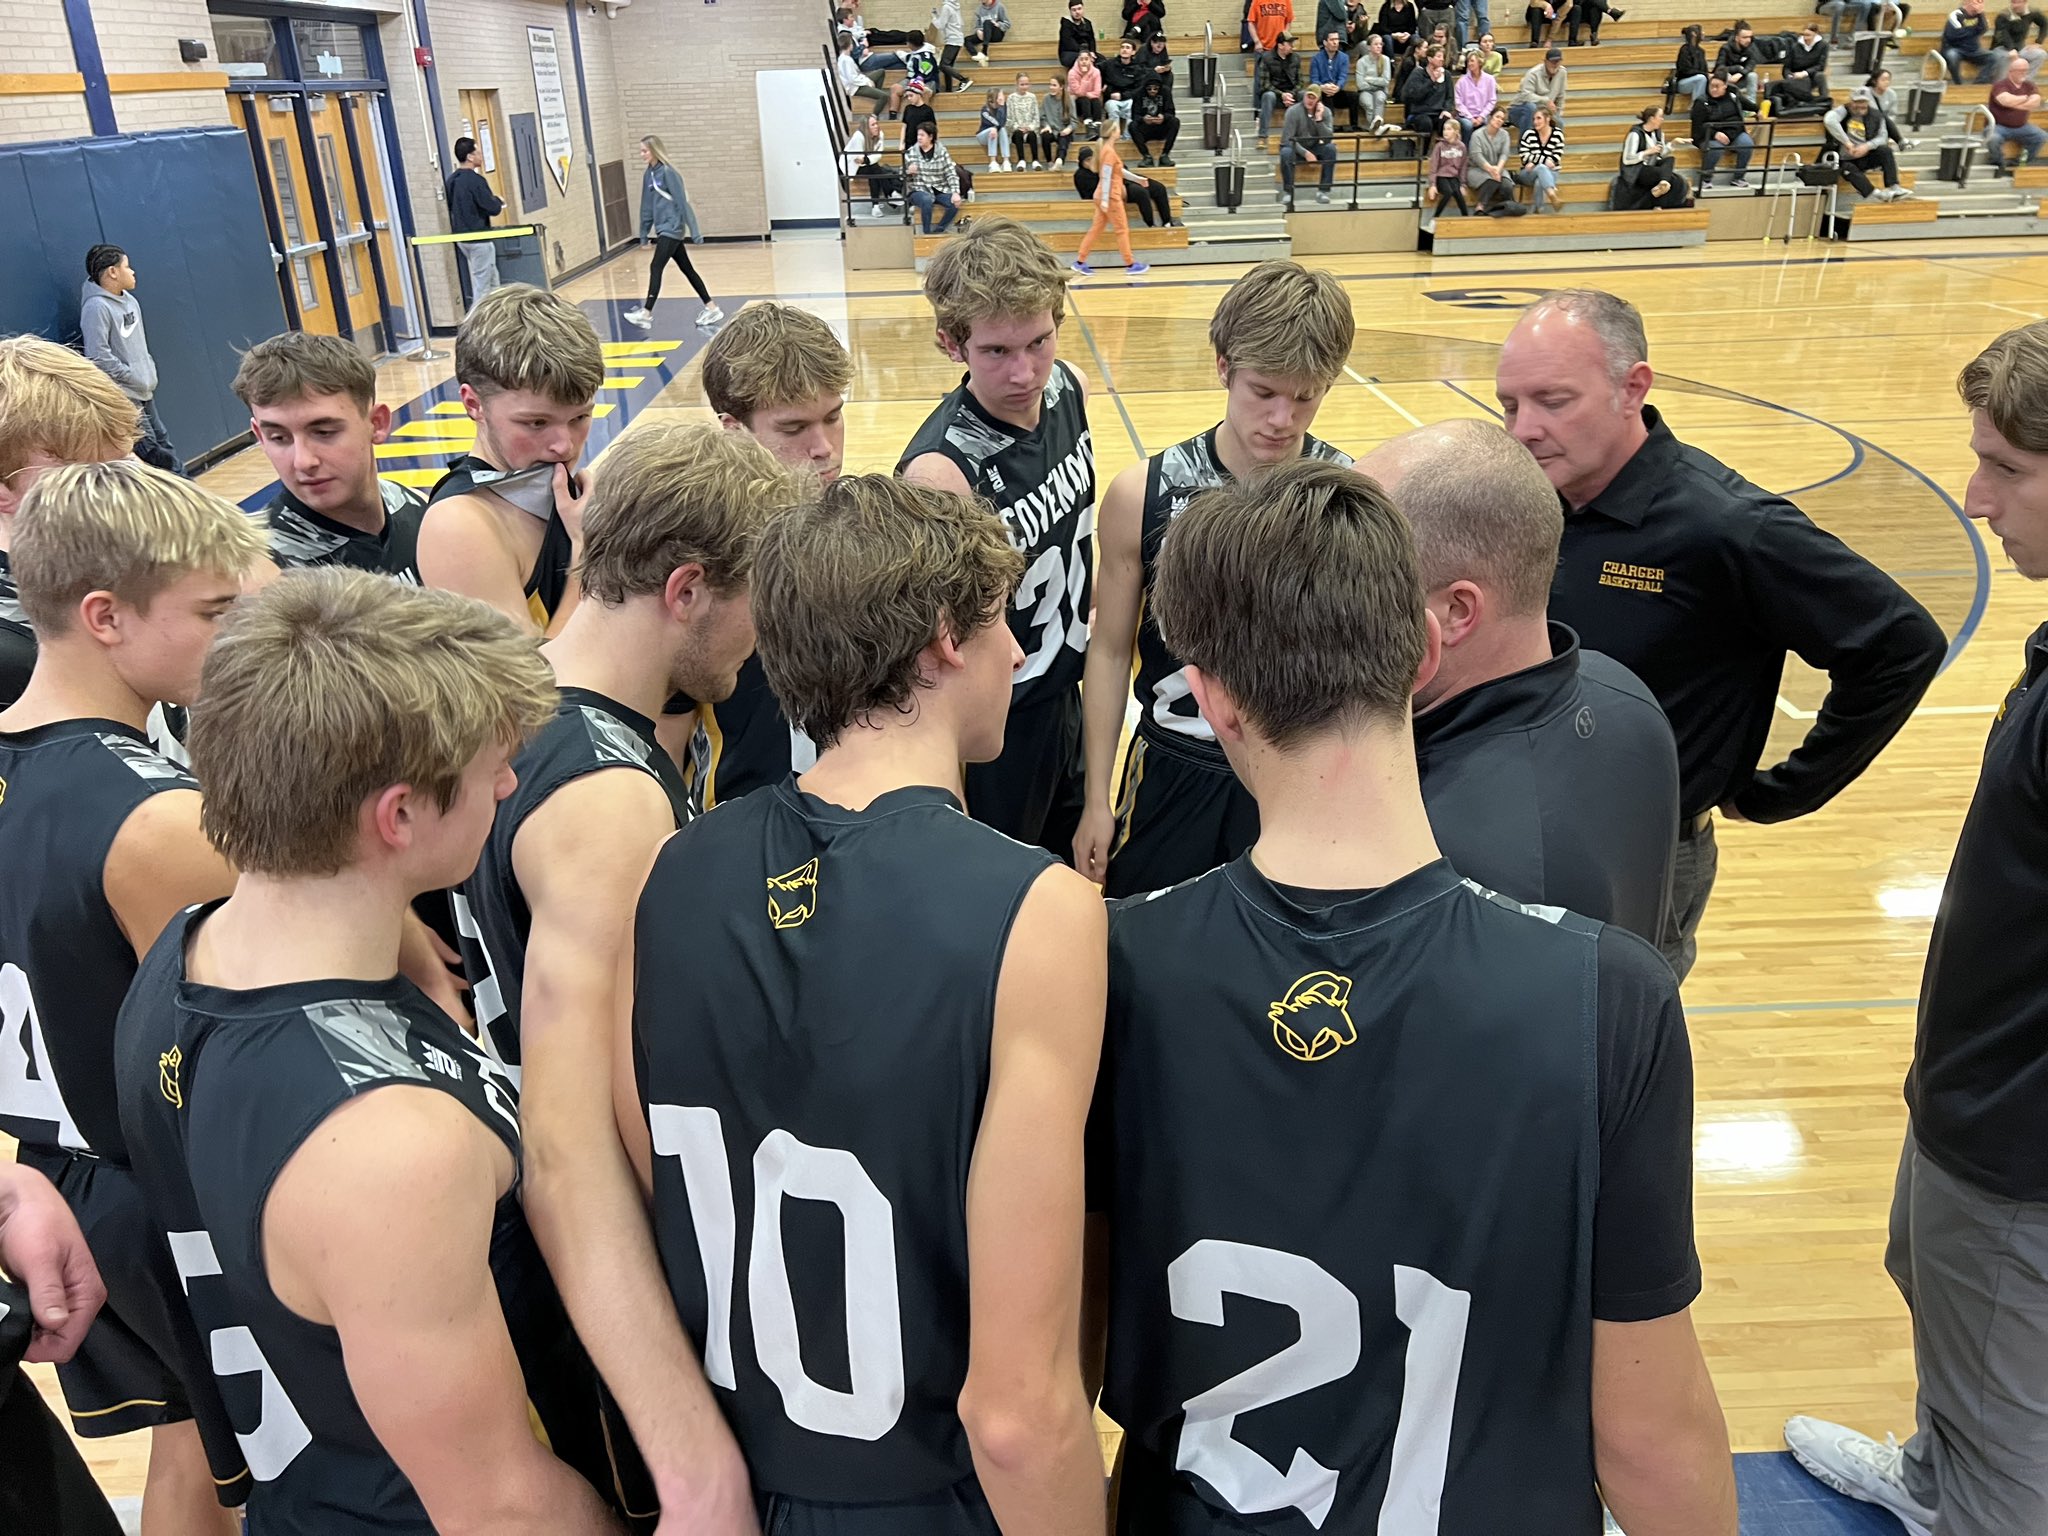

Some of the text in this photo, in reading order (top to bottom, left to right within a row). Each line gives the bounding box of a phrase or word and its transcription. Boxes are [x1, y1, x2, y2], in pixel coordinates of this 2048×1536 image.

[1598, 574, 1663, 593] BASKETBALL
[1603, 561, 1665, 581] CHARGER
[649, 1103, 905, 1441] 10
[1167, 1239, 1471, 1536] 21
